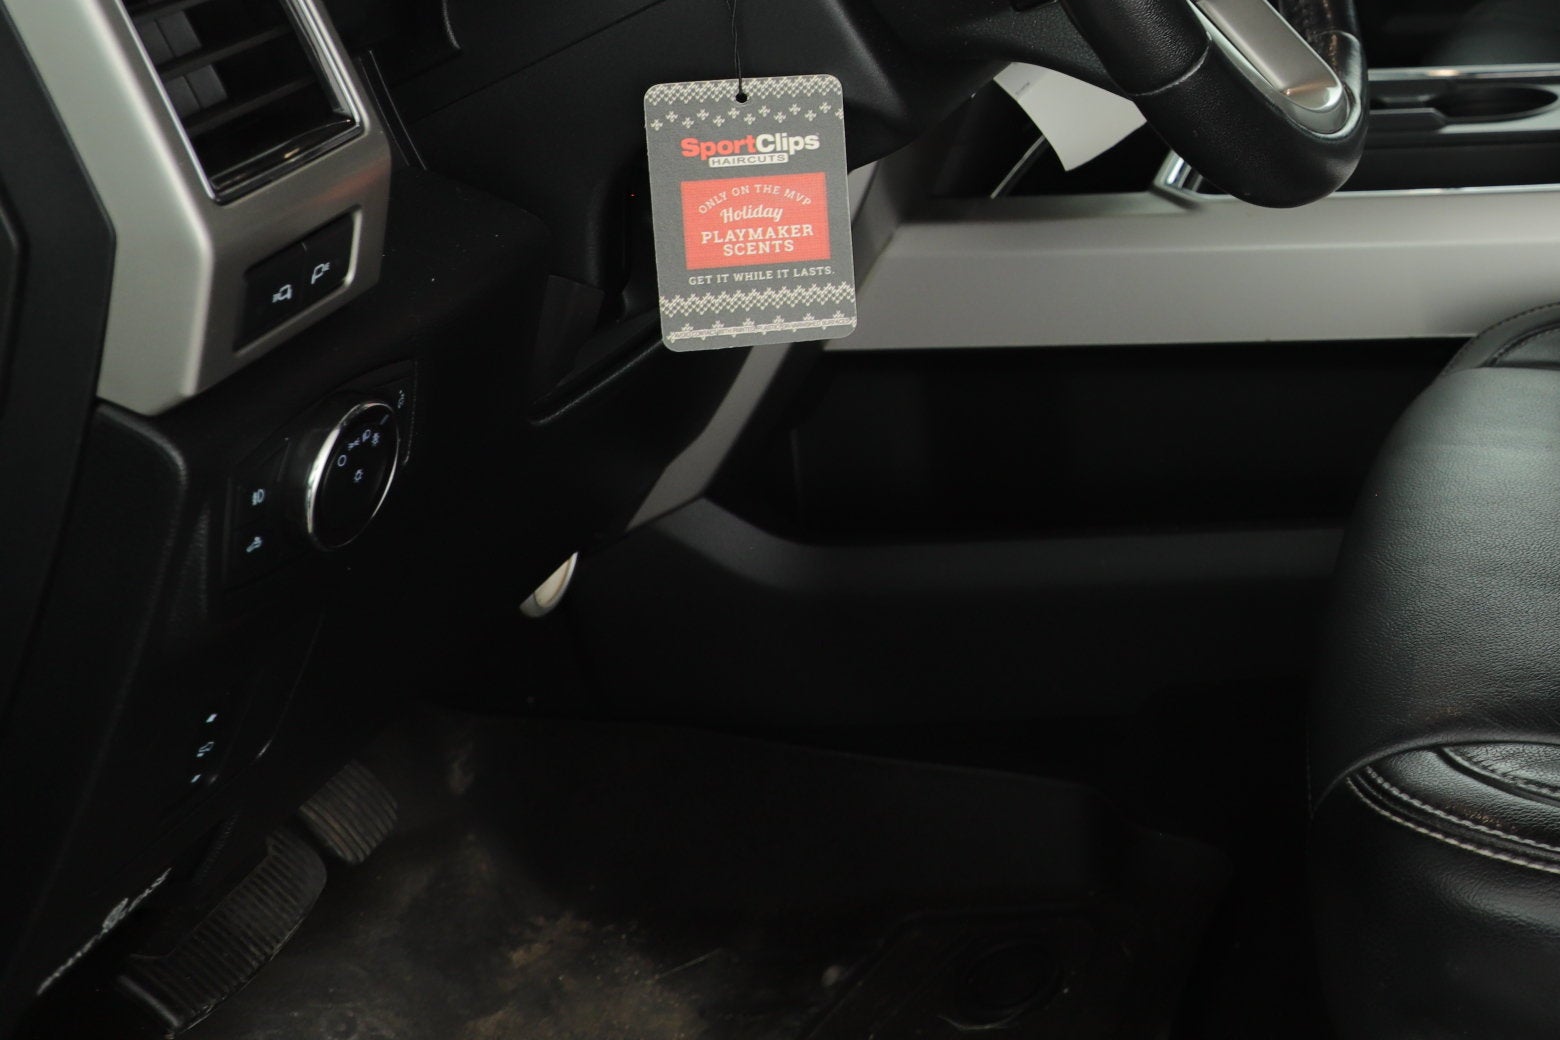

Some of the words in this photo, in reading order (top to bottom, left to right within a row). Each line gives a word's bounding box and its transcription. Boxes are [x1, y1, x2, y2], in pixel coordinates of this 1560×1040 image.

[711, 154, 786, 167] HAIRCUTS
[698, 191, 728, 215] ONLY
[731, 185, 750, 197] ON
[754, 183, 782, 195] THE
[783, 188, 813, 206] MVP
[720, 204, 784, 224] Holiday
[701, 223, 814, 245] PLAYMAKER
[723, 239, 795, 257] SCENTS
[688, 275, 712, 286] GET
[716, 274, 729, 284] IT
[733, 270, 774, 282] WHILE
[777, 269, 789, 279] IT
[793, 265, 836, 278] LASTS.
